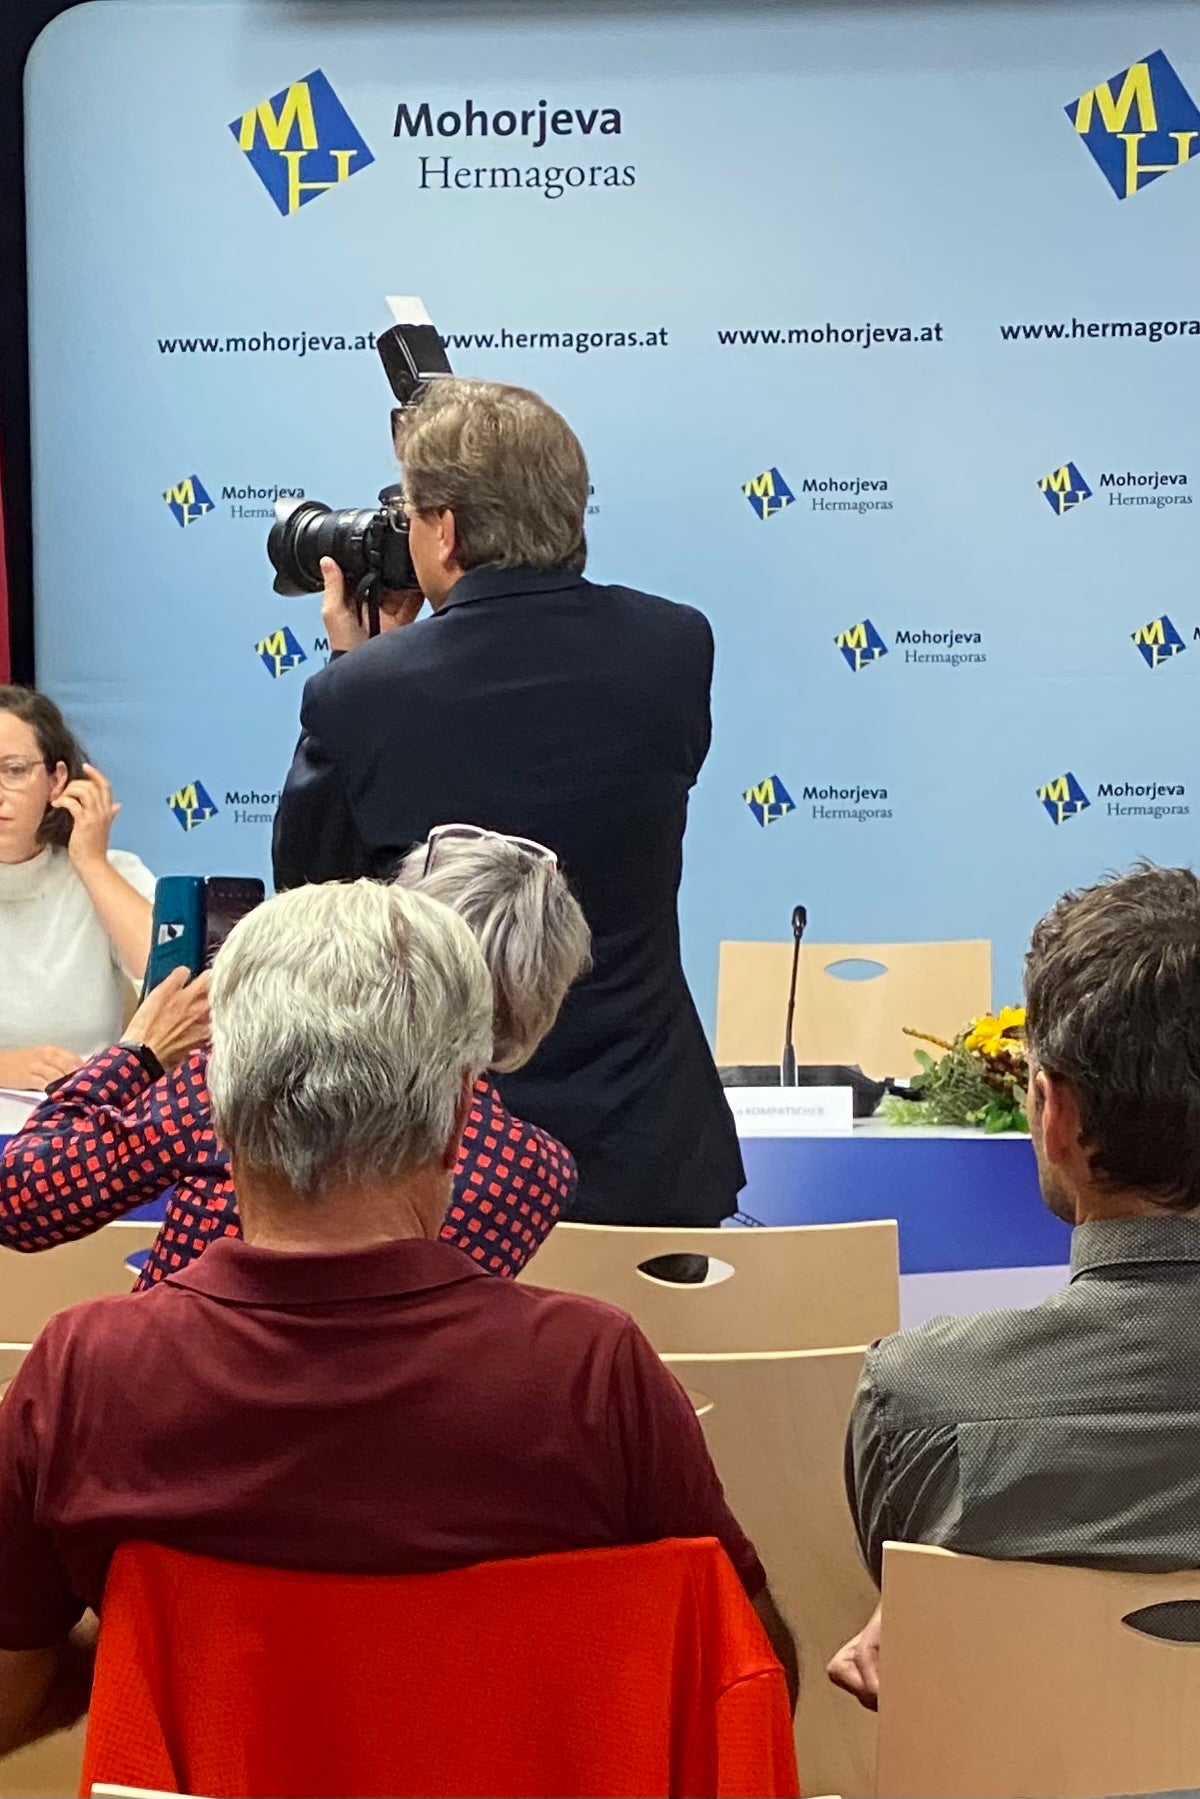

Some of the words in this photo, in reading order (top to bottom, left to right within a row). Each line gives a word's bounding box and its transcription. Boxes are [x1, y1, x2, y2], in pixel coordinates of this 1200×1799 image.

[393, 100, 622, 147] Mohorjeva
[418, 157, 636, 199] Hermagoras
[157, 331, 376, 355] www.mohorjeva.at
[718, 322, 944, 348] www.mohorjeva.at
[1000, 317, 1200, 342] www.hermagora
[802, 477, 888, 496] Mohorjeva
[1099, 471, 1188, 490] Mohorjeva
[221, 485, 305, 502] Mohorjeva
[1108, 493, 1193, 509] Hermagoras
[230, 505, 275, 519] Herma
[811, 498, 894, 514] Hermagoras
[895, 630, 982, 648] Mohorjeva
[904, 650, 987, 667] Hermagoras
[802, 785, 888, 804] Mohorjeva
[1097, 782, 1185, 801] Mohorjeva
[812, 805, 893, 822] Hermagoras
[1107, 802, 1190, 819] Hermagoras
